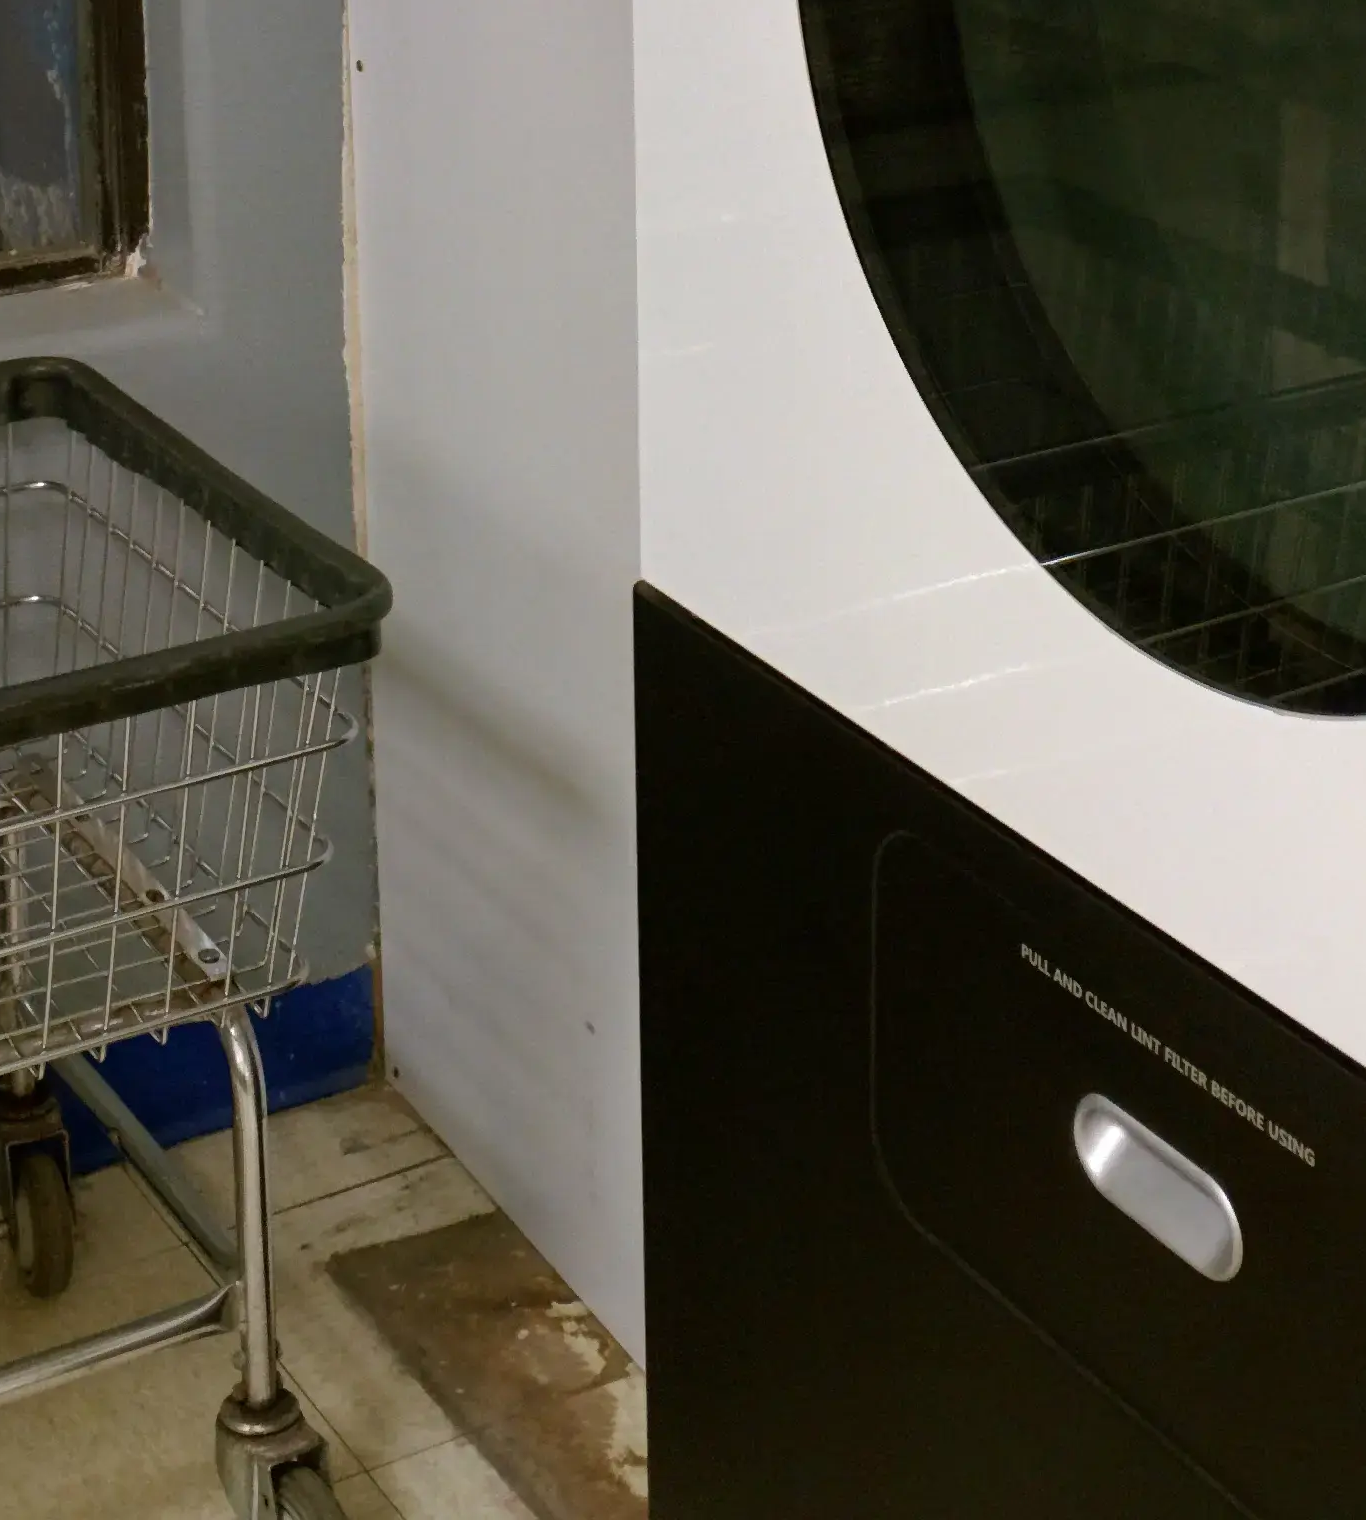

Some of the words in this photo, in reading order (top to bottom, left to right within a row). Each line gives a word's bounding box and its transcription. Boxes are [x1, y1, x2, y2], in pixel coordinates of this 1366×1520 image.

[1021, 945, 1050, 976] PULL
[1053, 969, 1082, 998] AND
[1085, 991, 1127, 1032] CLEAN
[1132, 1023, 1162, 1055] LINT
[1165, 1046, 1208, 1090] FILTER
[1211, 1080, 1265, 1130] BEFORE
[1269, 1121, 1316, 1167] USING
